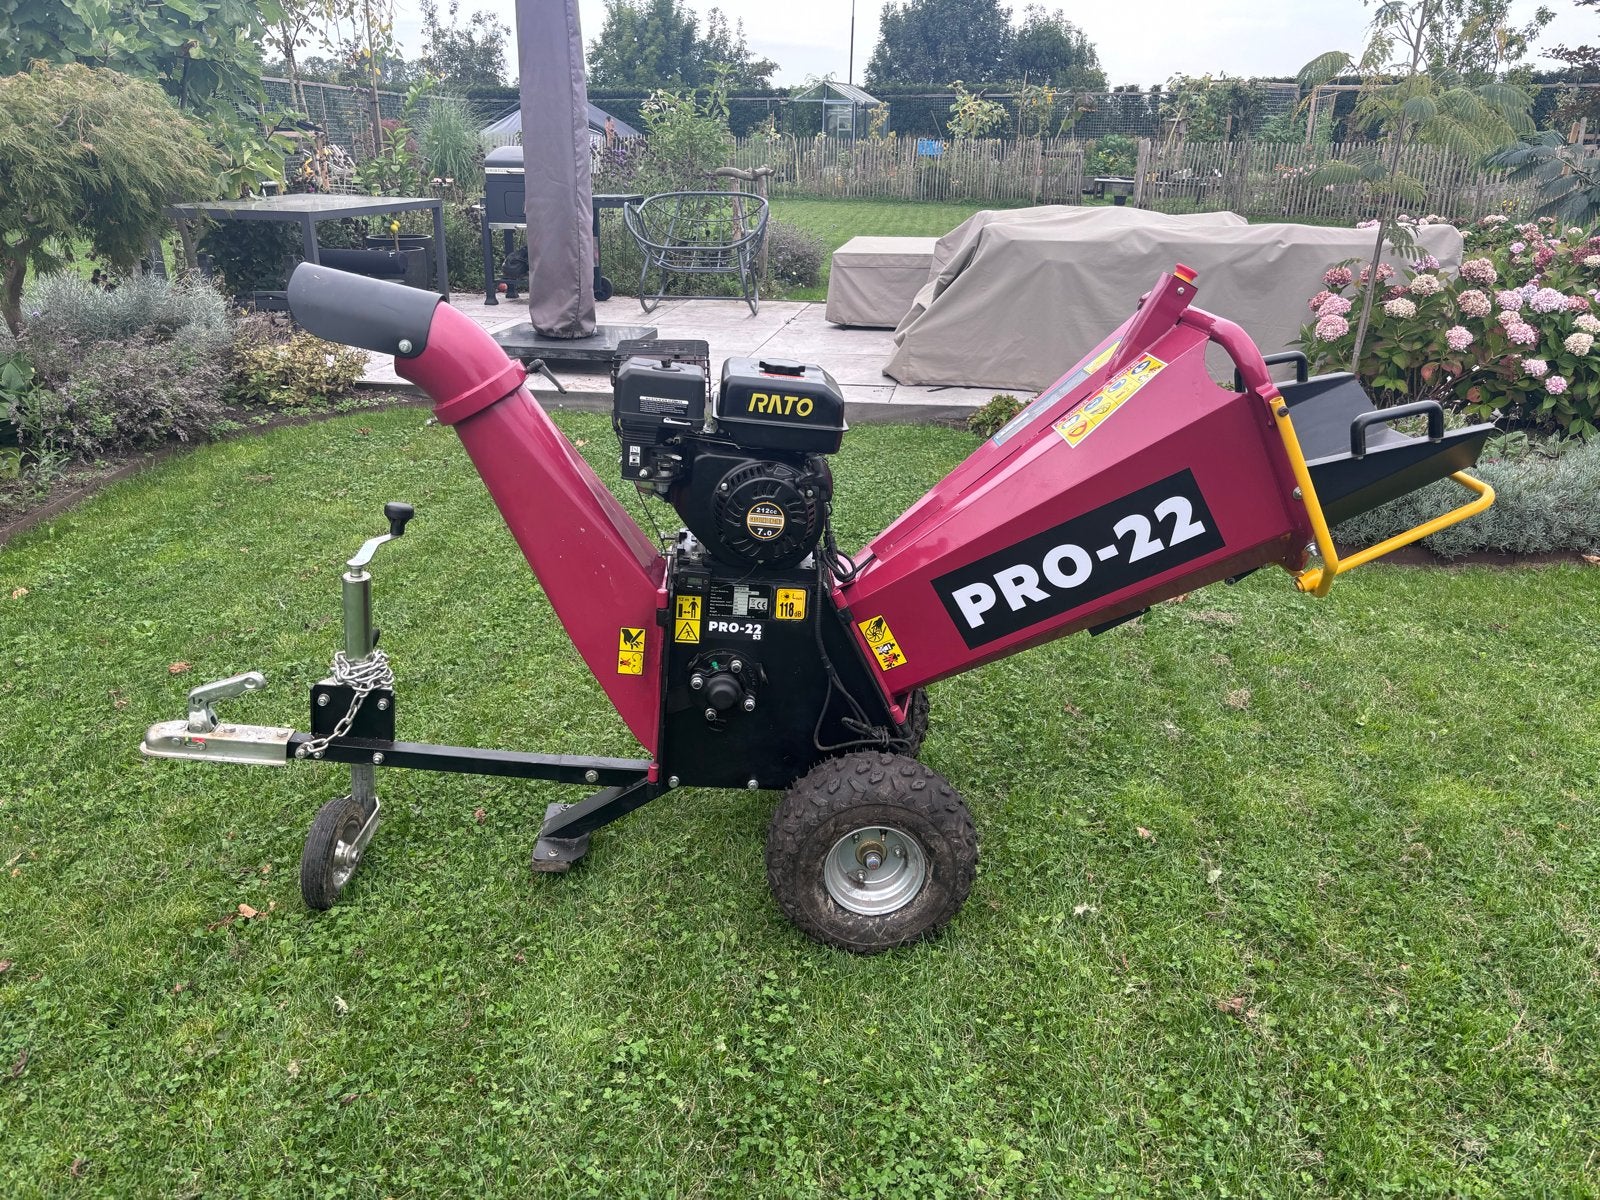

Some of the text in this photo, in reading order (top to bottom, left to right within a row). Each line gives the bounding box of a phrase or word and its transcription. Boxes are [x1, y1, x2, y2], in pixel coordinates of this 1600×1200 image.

[748, 393, 814, 417] RATO
[756, 507, 778, 515] 212cc
[757, 527, 772, 536] 7.0
[952, 496, 1206, 629] PRO-22
[780, 602, 794, 617] 118
[708, 621, 762, 634] PRO-22
